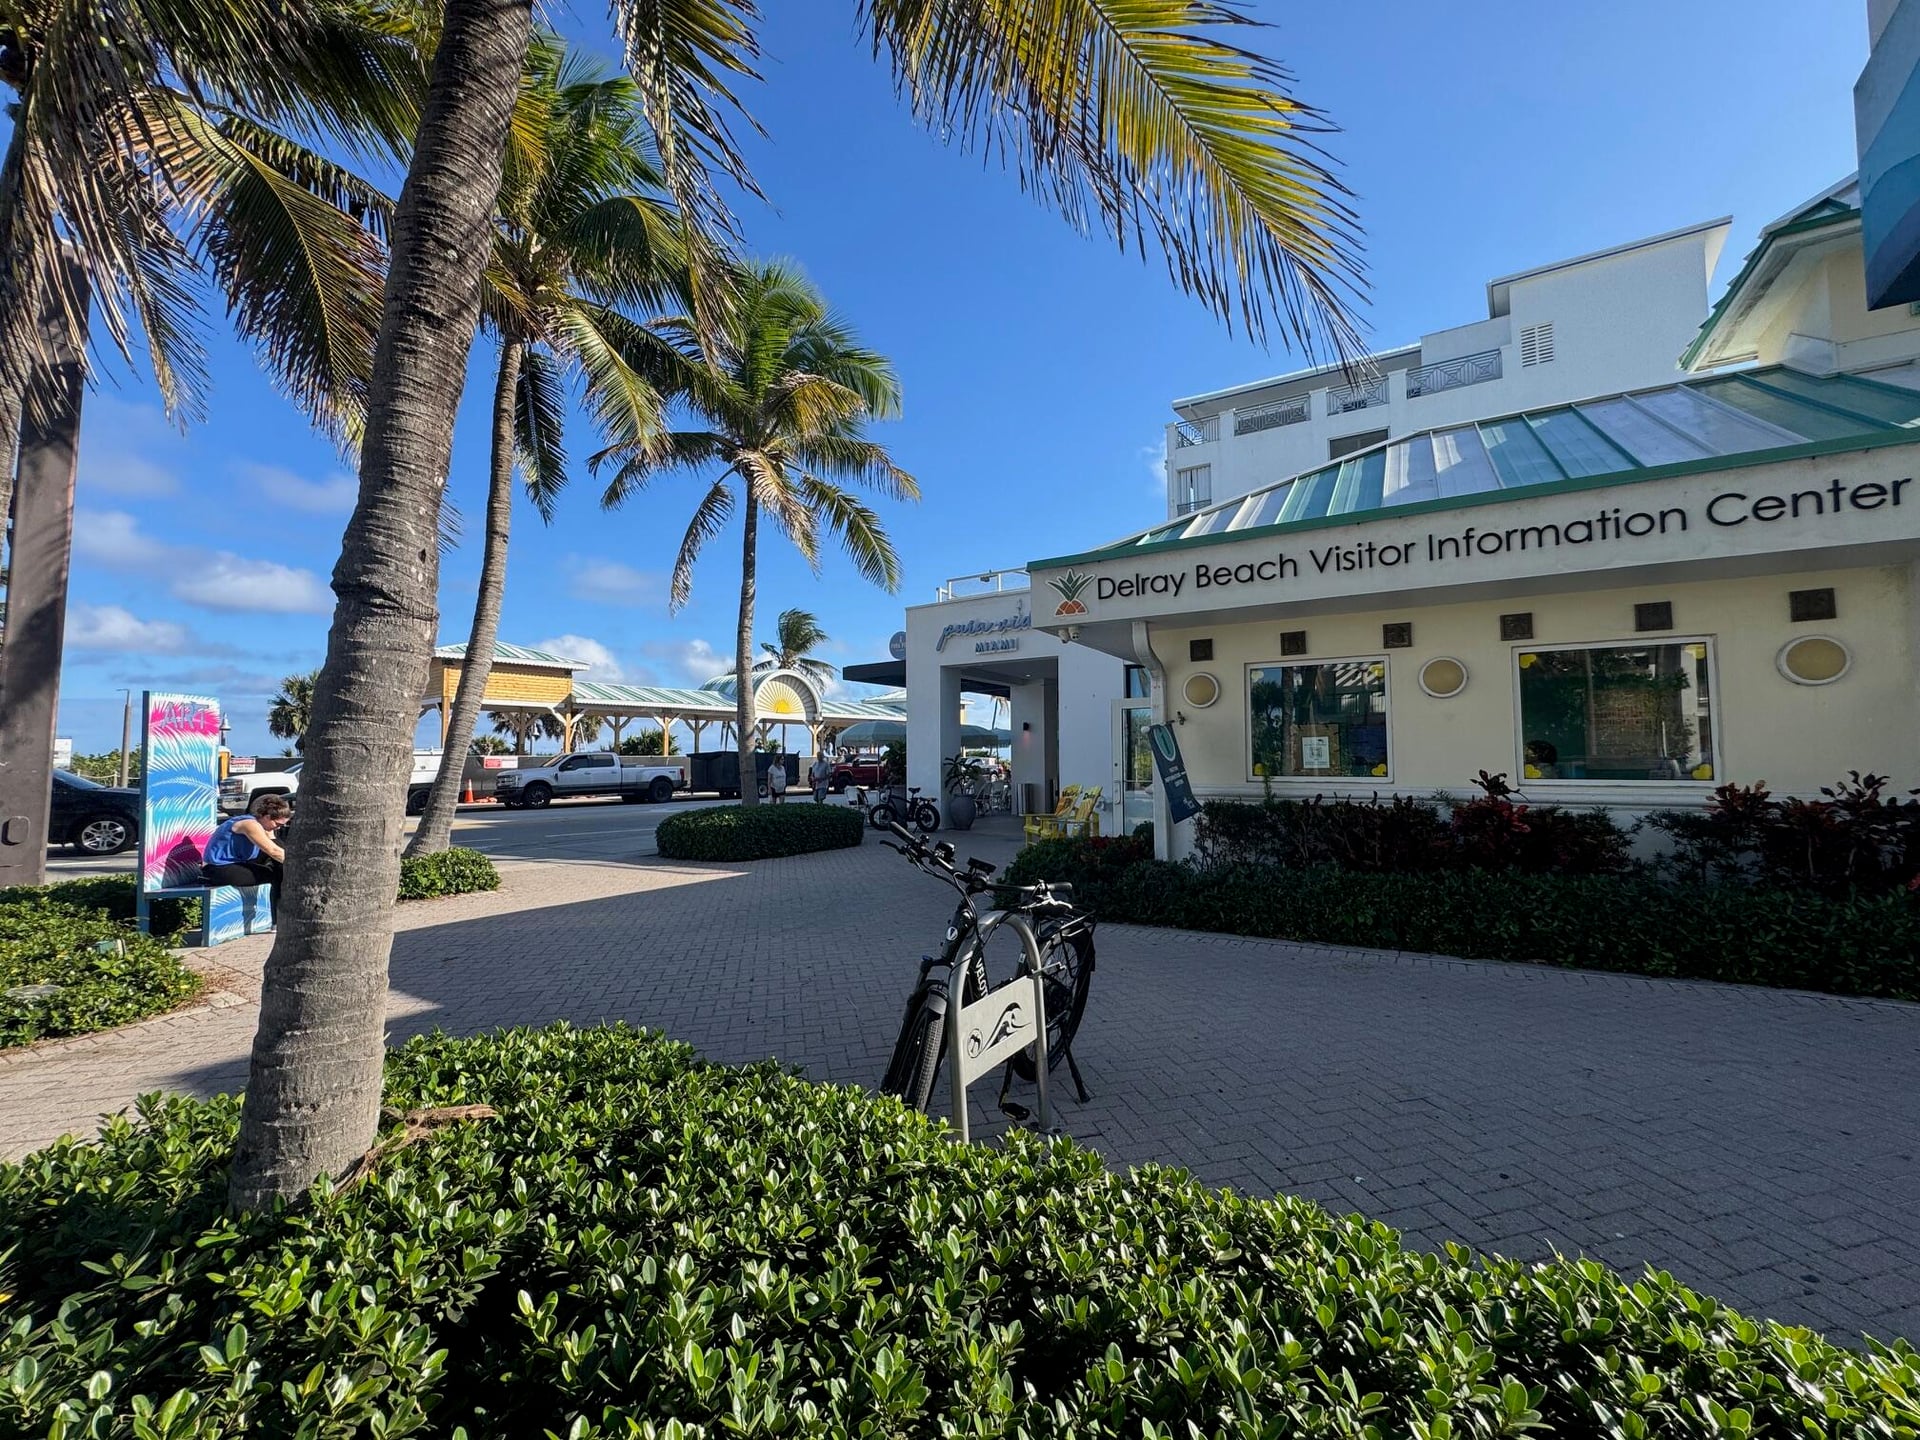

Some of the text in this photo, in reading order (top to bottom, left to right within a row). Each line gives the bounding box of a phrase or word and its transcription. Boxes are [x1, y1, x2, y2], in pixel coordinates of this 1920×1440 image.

[1097, 477, 1912, 600] Delray Beach Visitor Information Center
[975, 637, 1018, 655] MIAMI
[160, 700, 209, 729] ART
